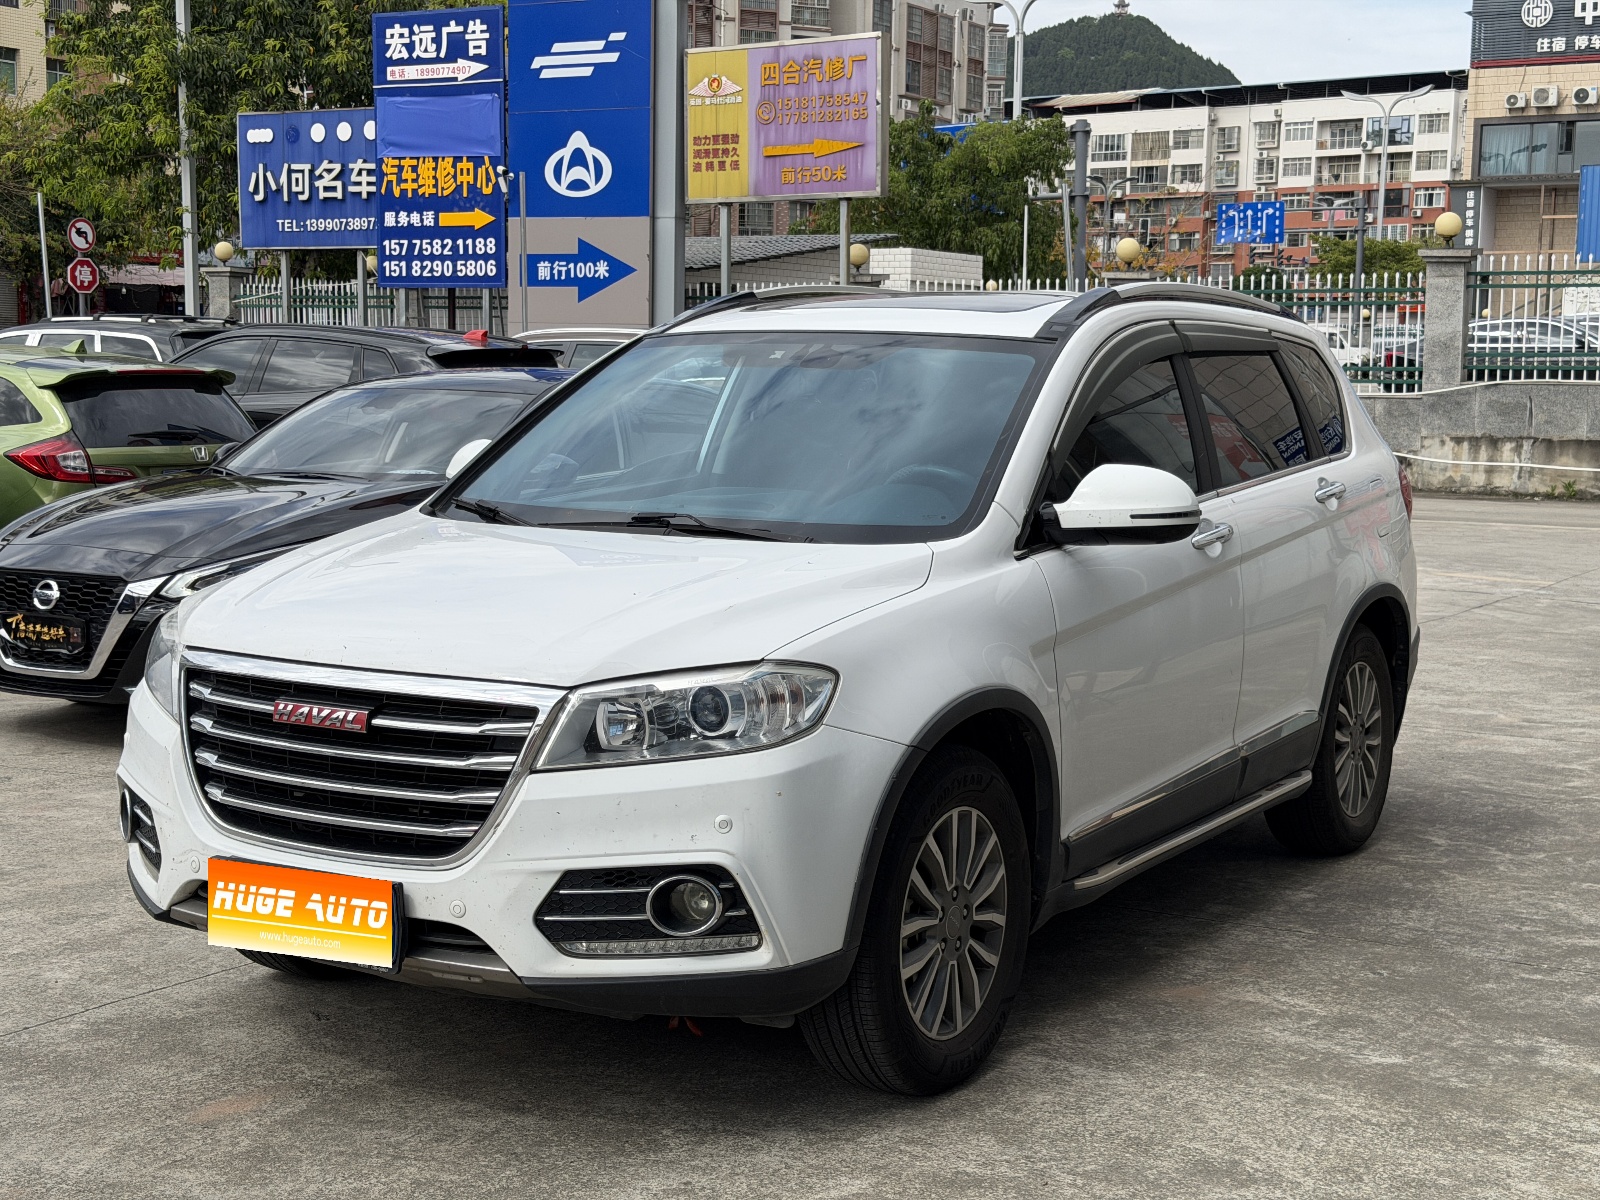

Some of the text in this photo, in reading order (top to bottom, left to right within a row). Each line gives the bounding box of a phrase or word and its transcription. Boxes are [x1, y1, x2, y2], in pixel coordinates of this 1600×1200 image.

[384, 19, 490, 60] 宏远广告
[1536, 35, 1600, 52] 住宿 停车
[415, 65, 472, 78] 18990774907
[761, 55, 867, 87] 四合汽修厂
[777, 91, 868, 111] 15181758547
[777, 107, 868, 125] 17781282165
[693, 133, 740, 146] 动力更强劲
[693, 147, 740, 160] 润滑更持久
[248, 158, 377, 202] 小何名车
[381, 156, 497, 198] 汽车维修中心
[781, 165, 847, 185] 前行50米
[276, 217, 378, 232] TEL:1399073897
[384, 211, 435, 227] 服务电话
[383, 238, 496, 256] 157 7582 1188
[75, 264, 93, 287] 停
[383, 260, 496, 277] 151 8290 5806
[537, 260, 609, 281] 前行100米
[275, 703, 362, 730] HAVAL
